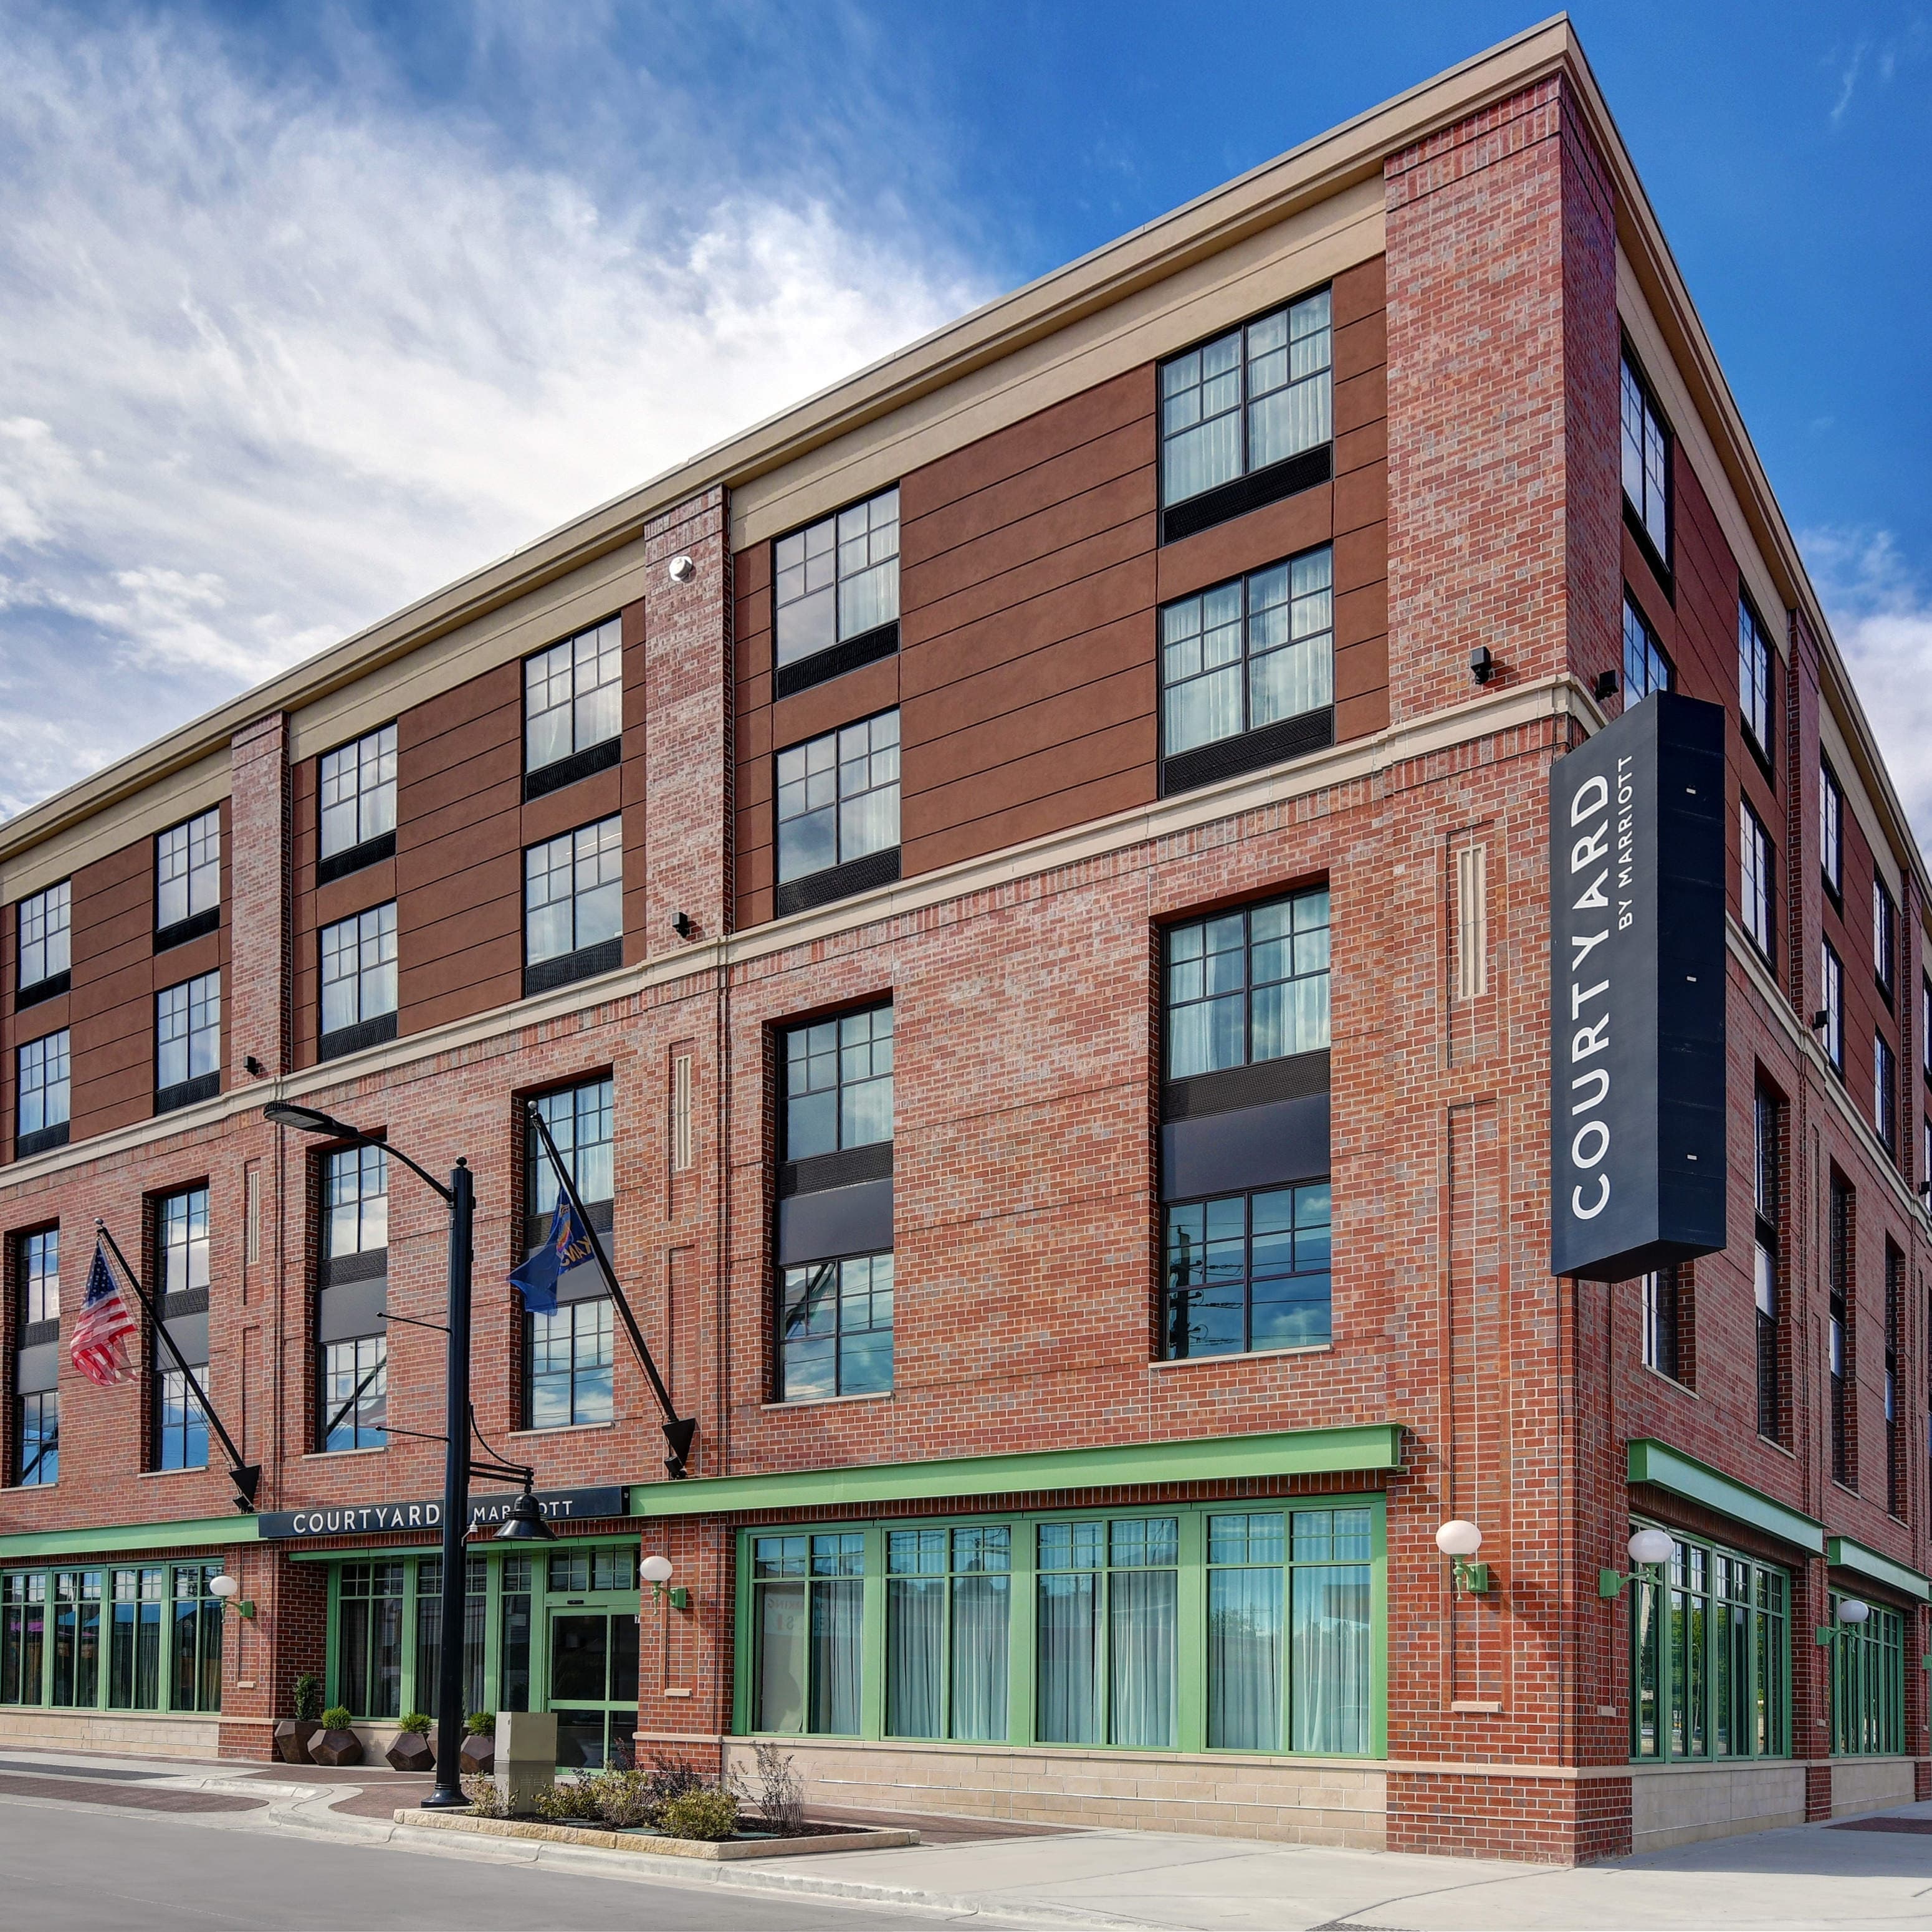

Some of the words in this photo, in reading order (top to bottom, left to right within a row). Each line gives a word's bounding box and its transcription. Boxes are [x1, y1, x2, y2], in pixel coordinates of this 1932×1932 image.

[1618, 755, 1633, 889] MARRIOTT
[1618, 899, 1633, 931] BY
[1571, 775, 1610, 1220] COURTYARD
[293, 1504, 440, 1534] COURTYARD
[474, 1500, 573, 1521] MAROTT
